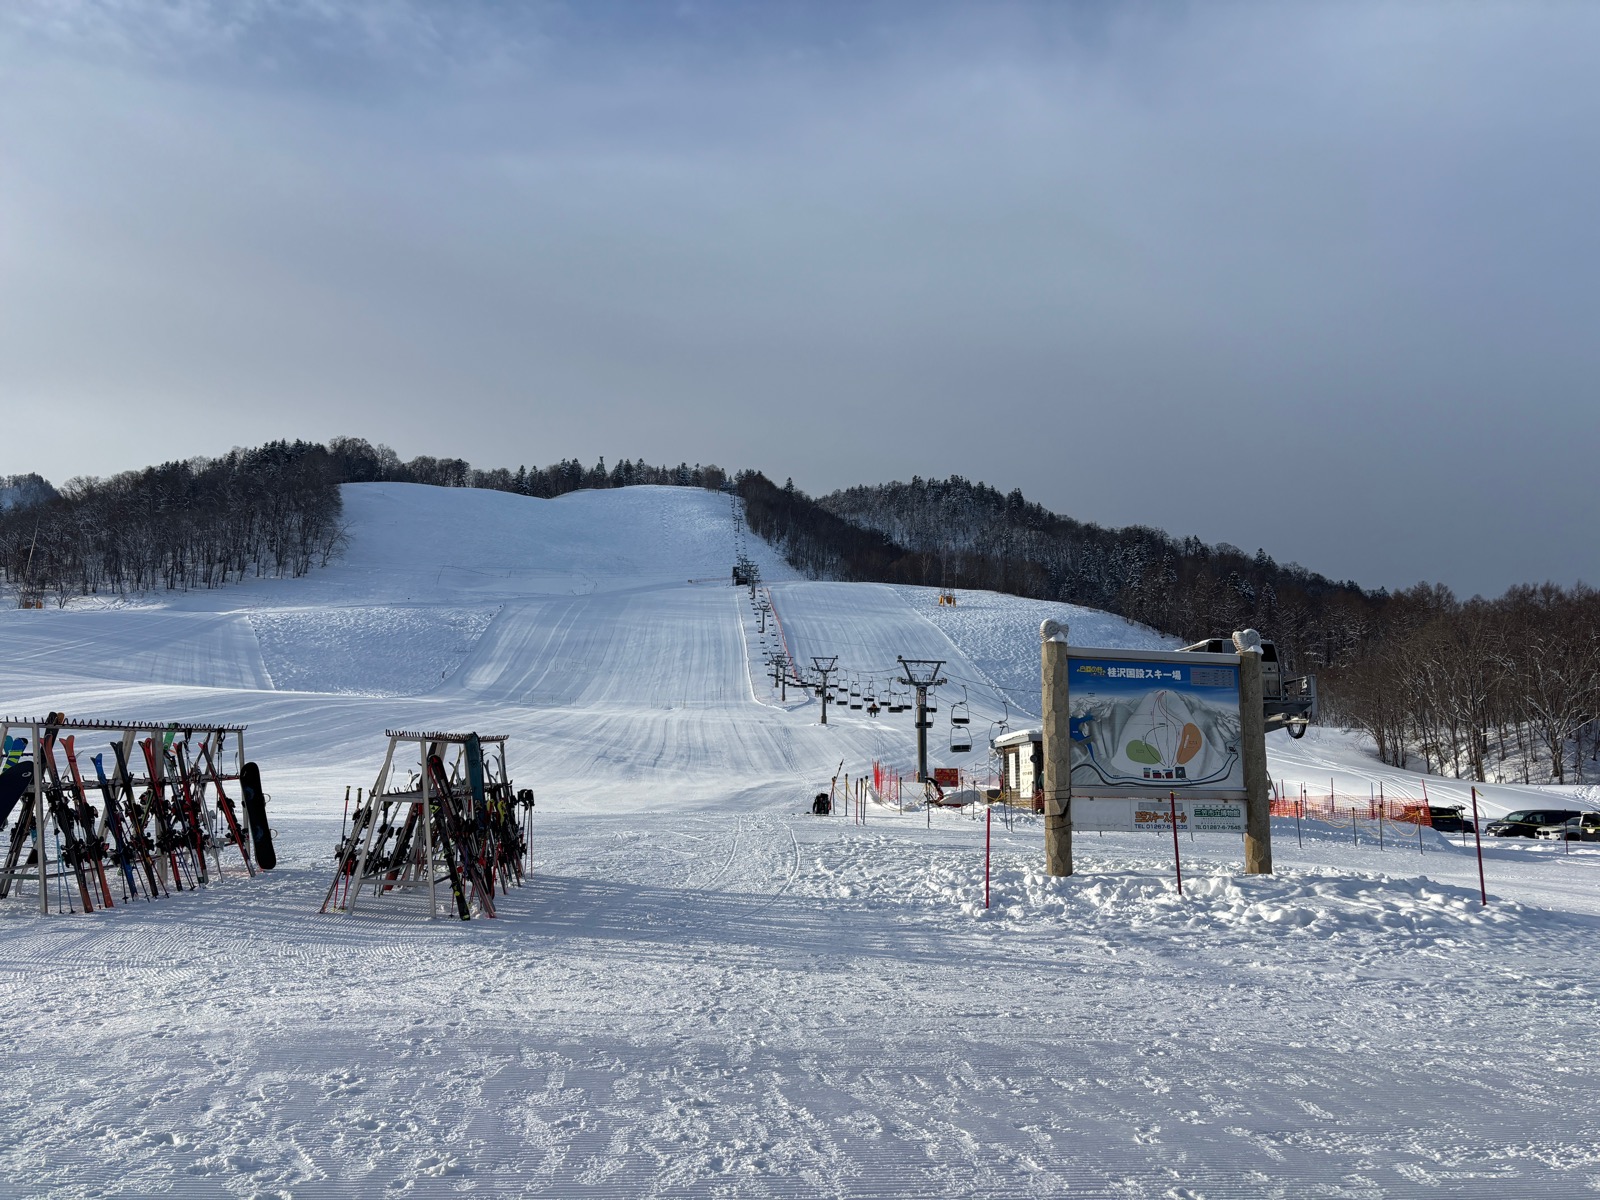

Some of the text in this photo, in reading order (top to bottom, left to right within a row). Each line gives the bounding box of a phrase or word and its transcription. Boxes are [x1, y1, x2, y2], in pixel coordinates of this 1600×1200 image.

[1107, 667, 1181, 680] 桂沢国設スキー場
